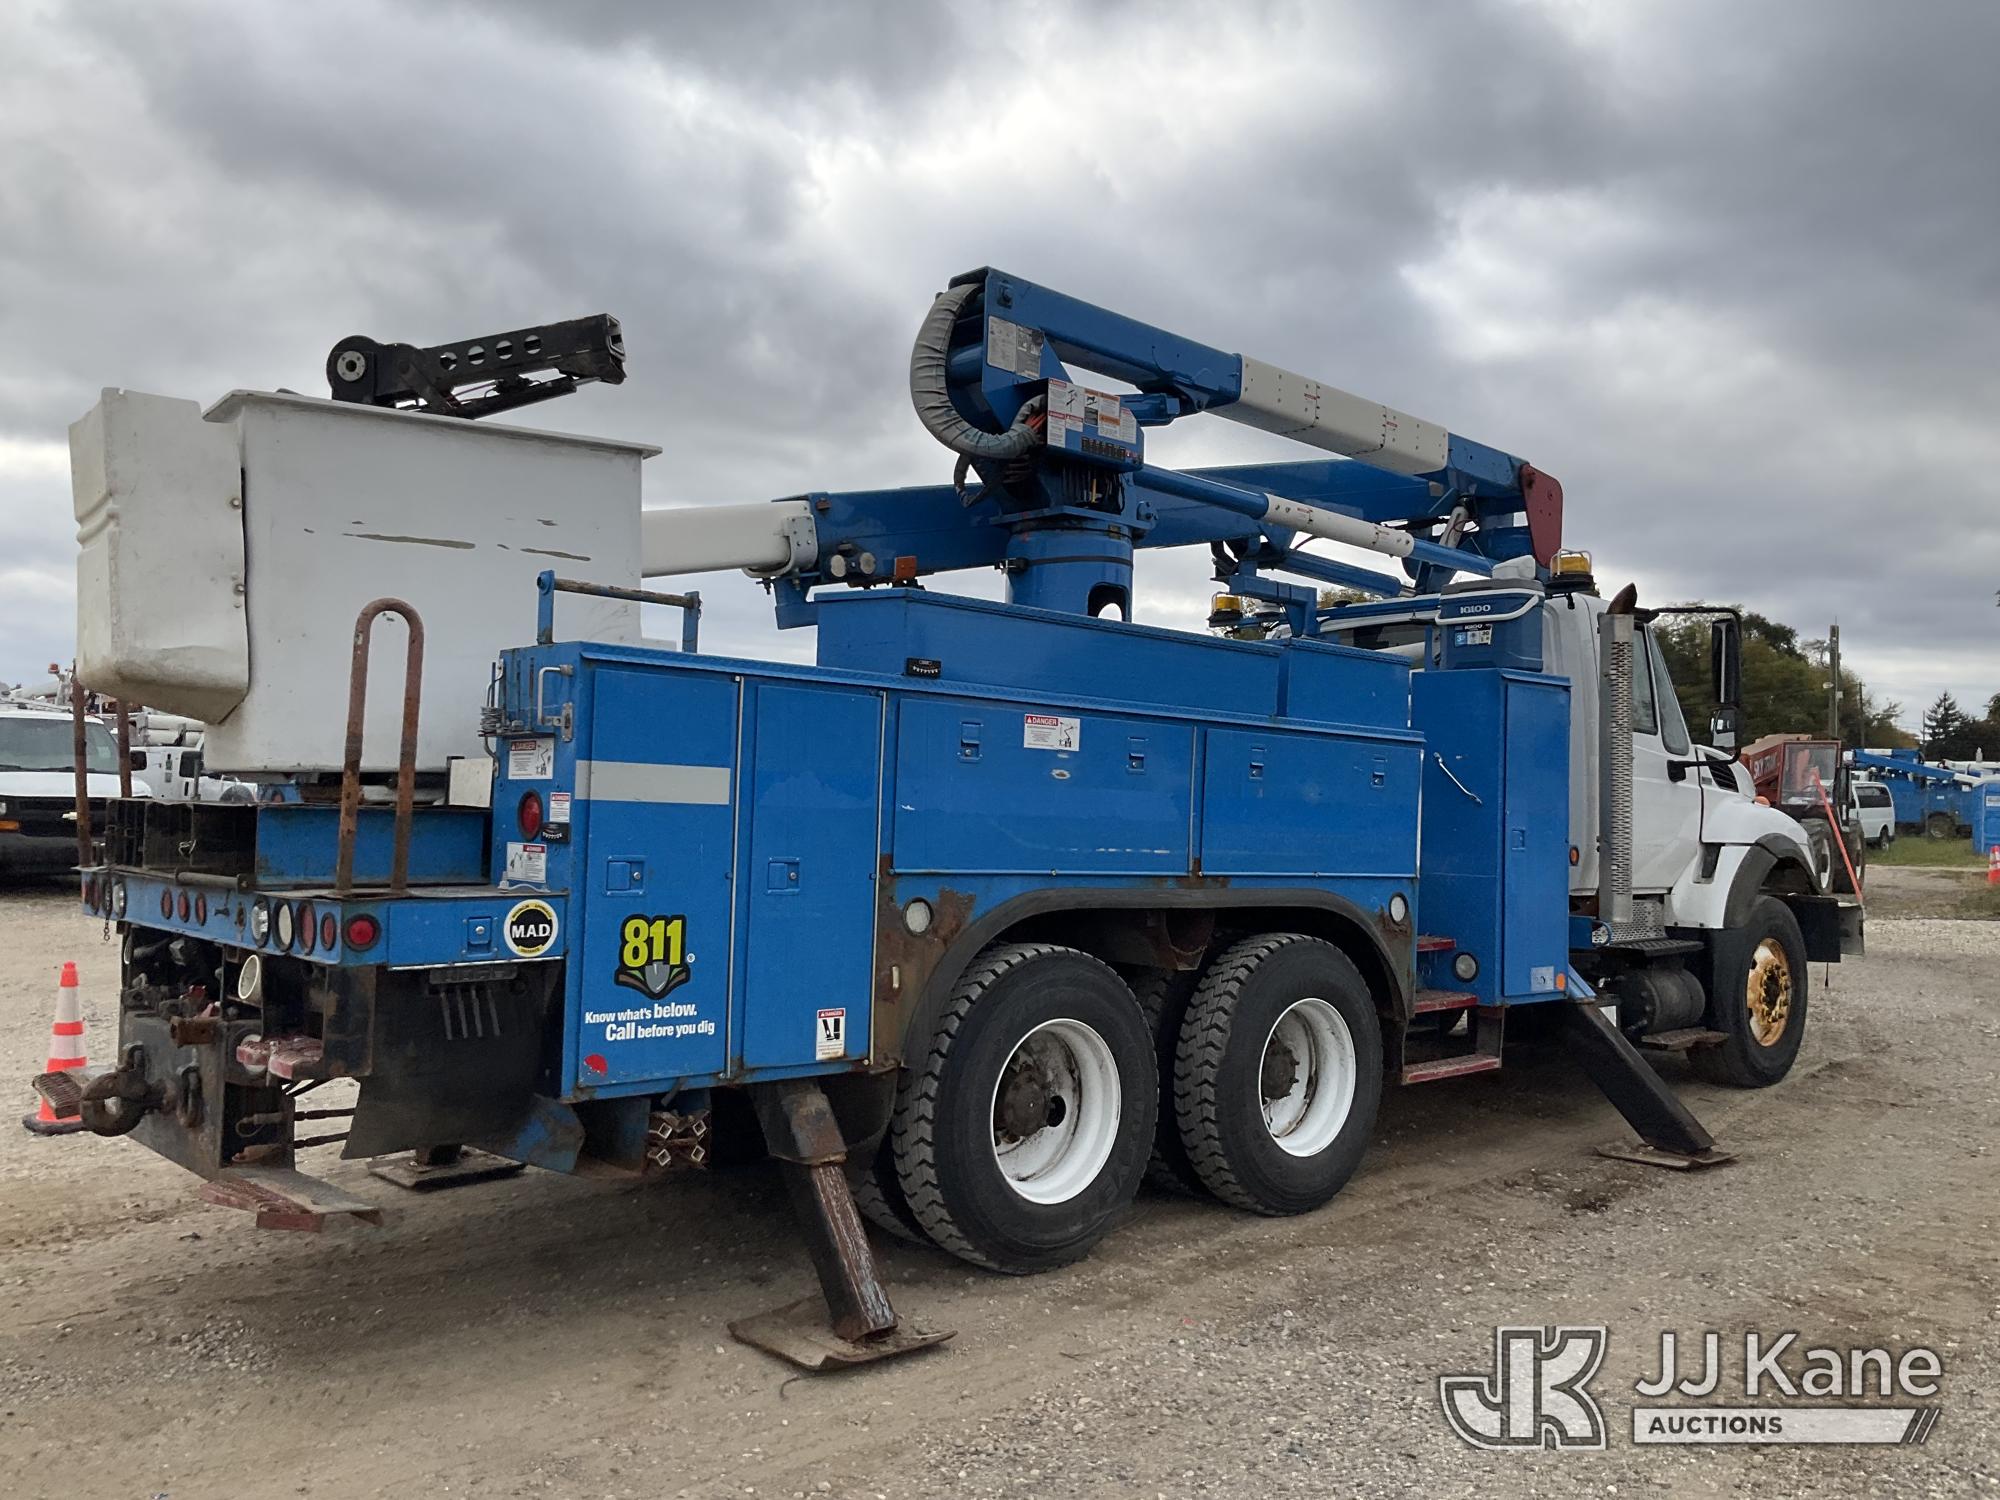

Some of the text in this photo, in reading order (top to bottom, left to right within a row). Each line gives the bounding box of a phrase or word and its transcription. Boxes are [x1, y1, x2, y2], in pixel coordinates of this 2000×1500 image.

[1460, 604, 1491, 614] IGLOO
[1032, 717, 1057, 726] DANGER
[623, 918, 682, 968] 811
[585, 1002, 698, 1024] Know what's below.
[605, 1020, 716, 1042] Call before you dig
